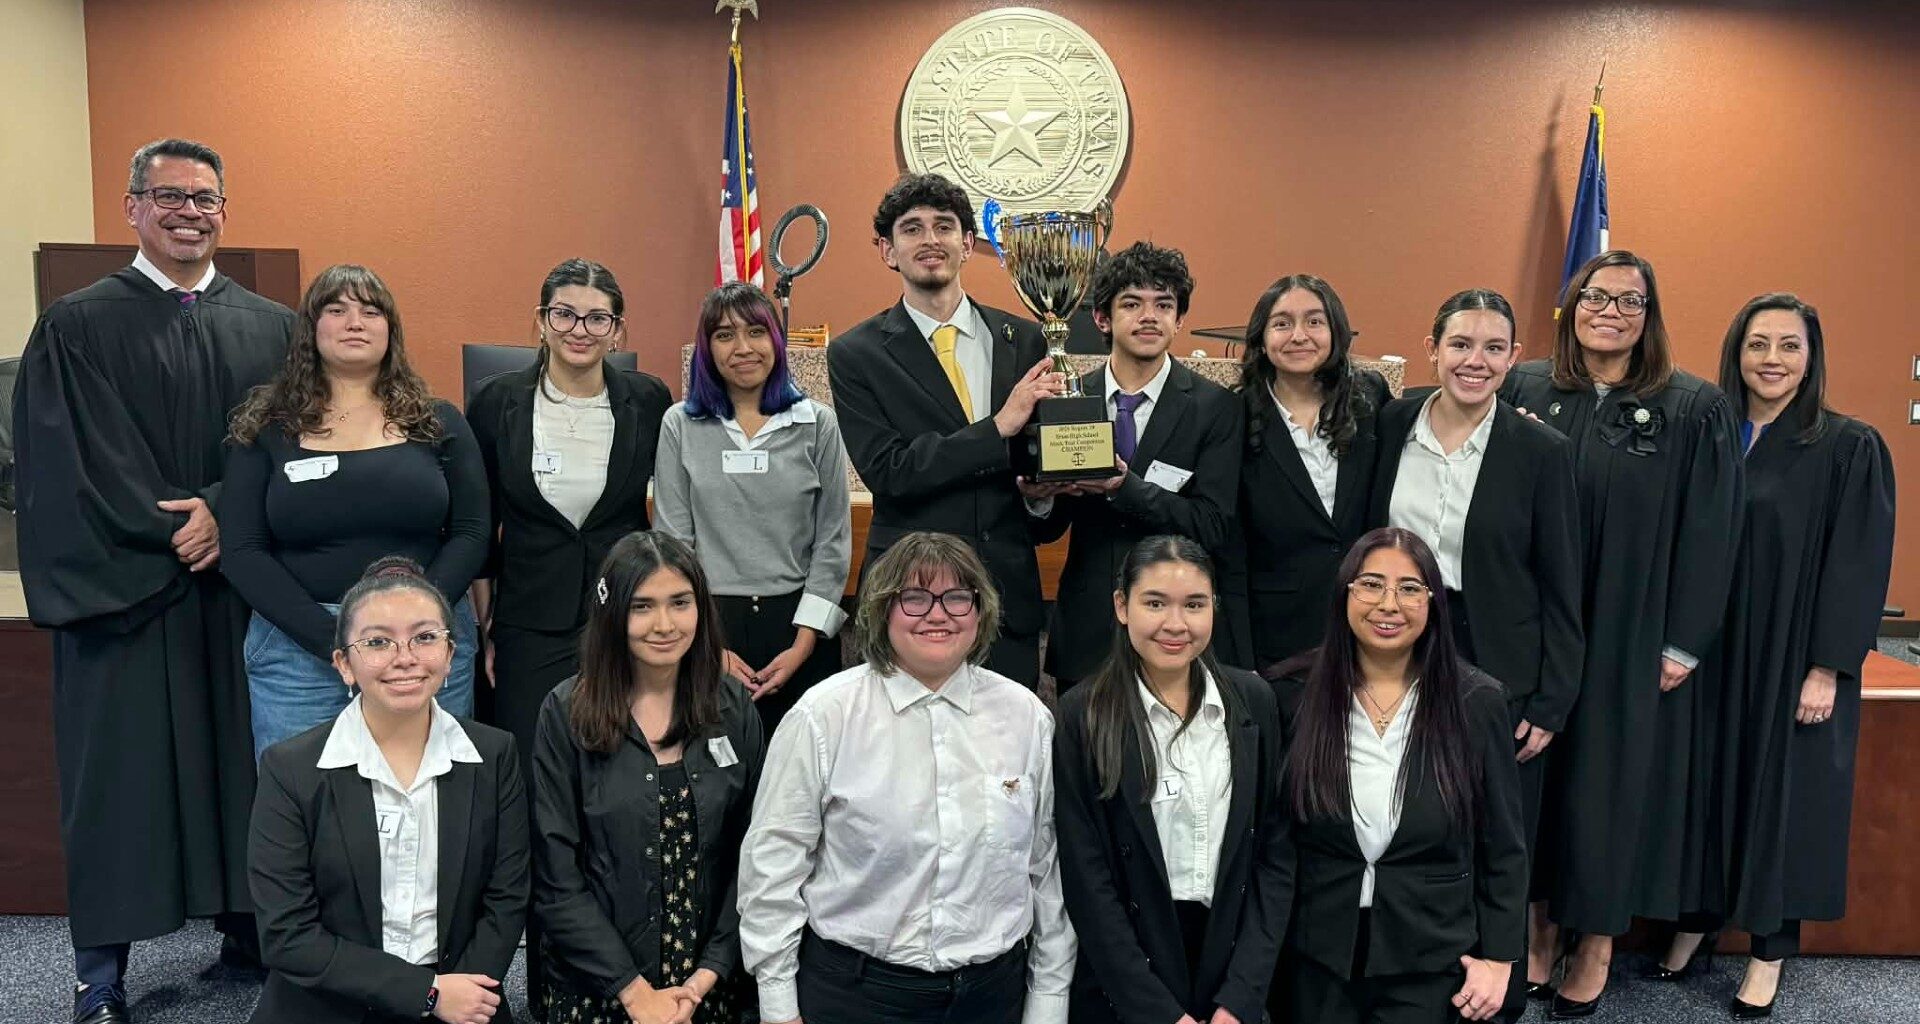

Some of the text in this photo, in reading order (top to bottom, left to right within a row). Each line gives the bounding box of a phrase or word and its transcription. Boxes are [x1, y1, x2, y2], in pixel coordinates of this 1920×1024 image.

[932, 26, 1016, 93] STATE
[1036, 32, 1079, 64] OF
[1079, 63, 1114, 180] TEXAS
[753, 456, 763, 470] L
[1162, 780, 1177, 796] L
[379, 814, 391, 833] L
